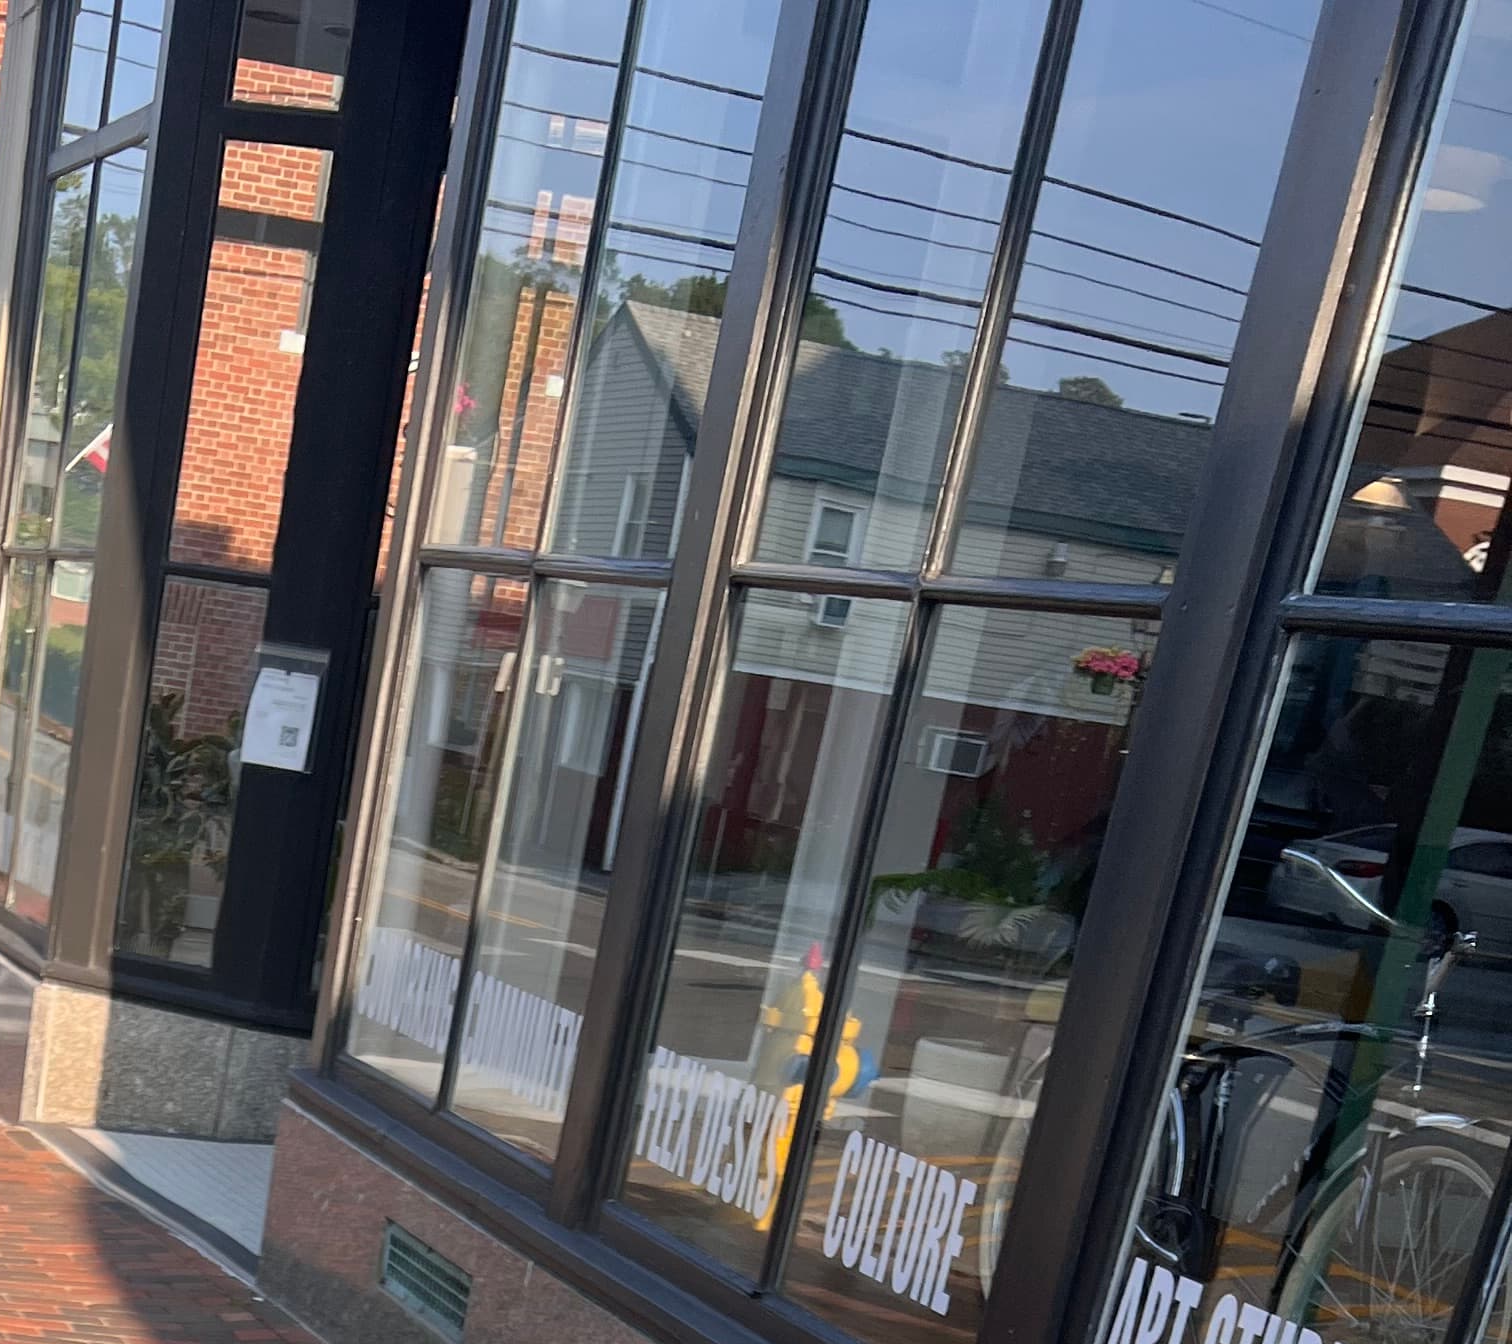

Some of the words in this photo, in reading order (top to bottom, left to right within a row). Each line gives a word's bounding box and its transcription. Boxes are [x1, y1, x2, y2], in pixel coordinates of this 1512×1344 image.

[636, 1046, 706, 1177] FLEX
[691, 1070, 789, 1220] DESKS
[823, 1130, 978, 1316] CULTURE
